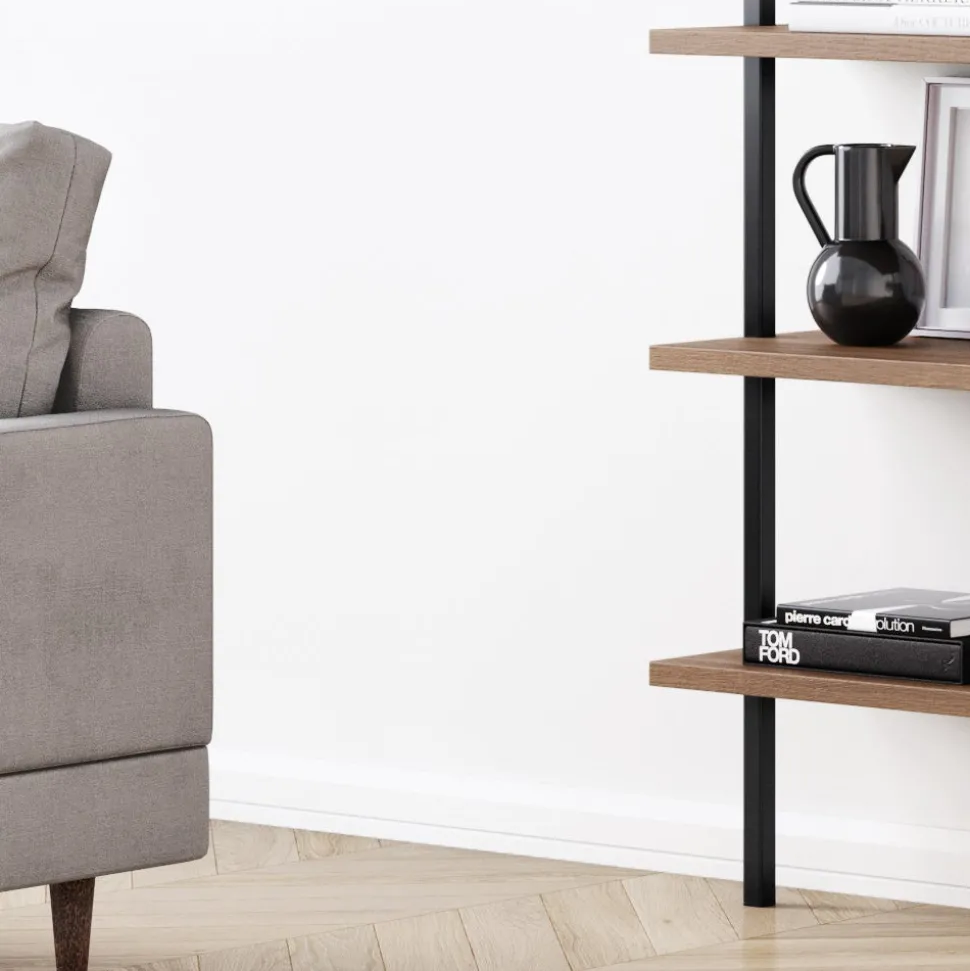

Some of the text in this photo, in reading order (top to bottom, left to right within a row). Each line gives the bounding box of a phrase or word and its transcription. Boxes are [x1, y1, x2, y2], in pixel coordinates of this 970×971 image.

[785, 610, 821, 625] pierre
[759, 630, 793, 649] TOM
[759, 647, 800, 665] FORD
